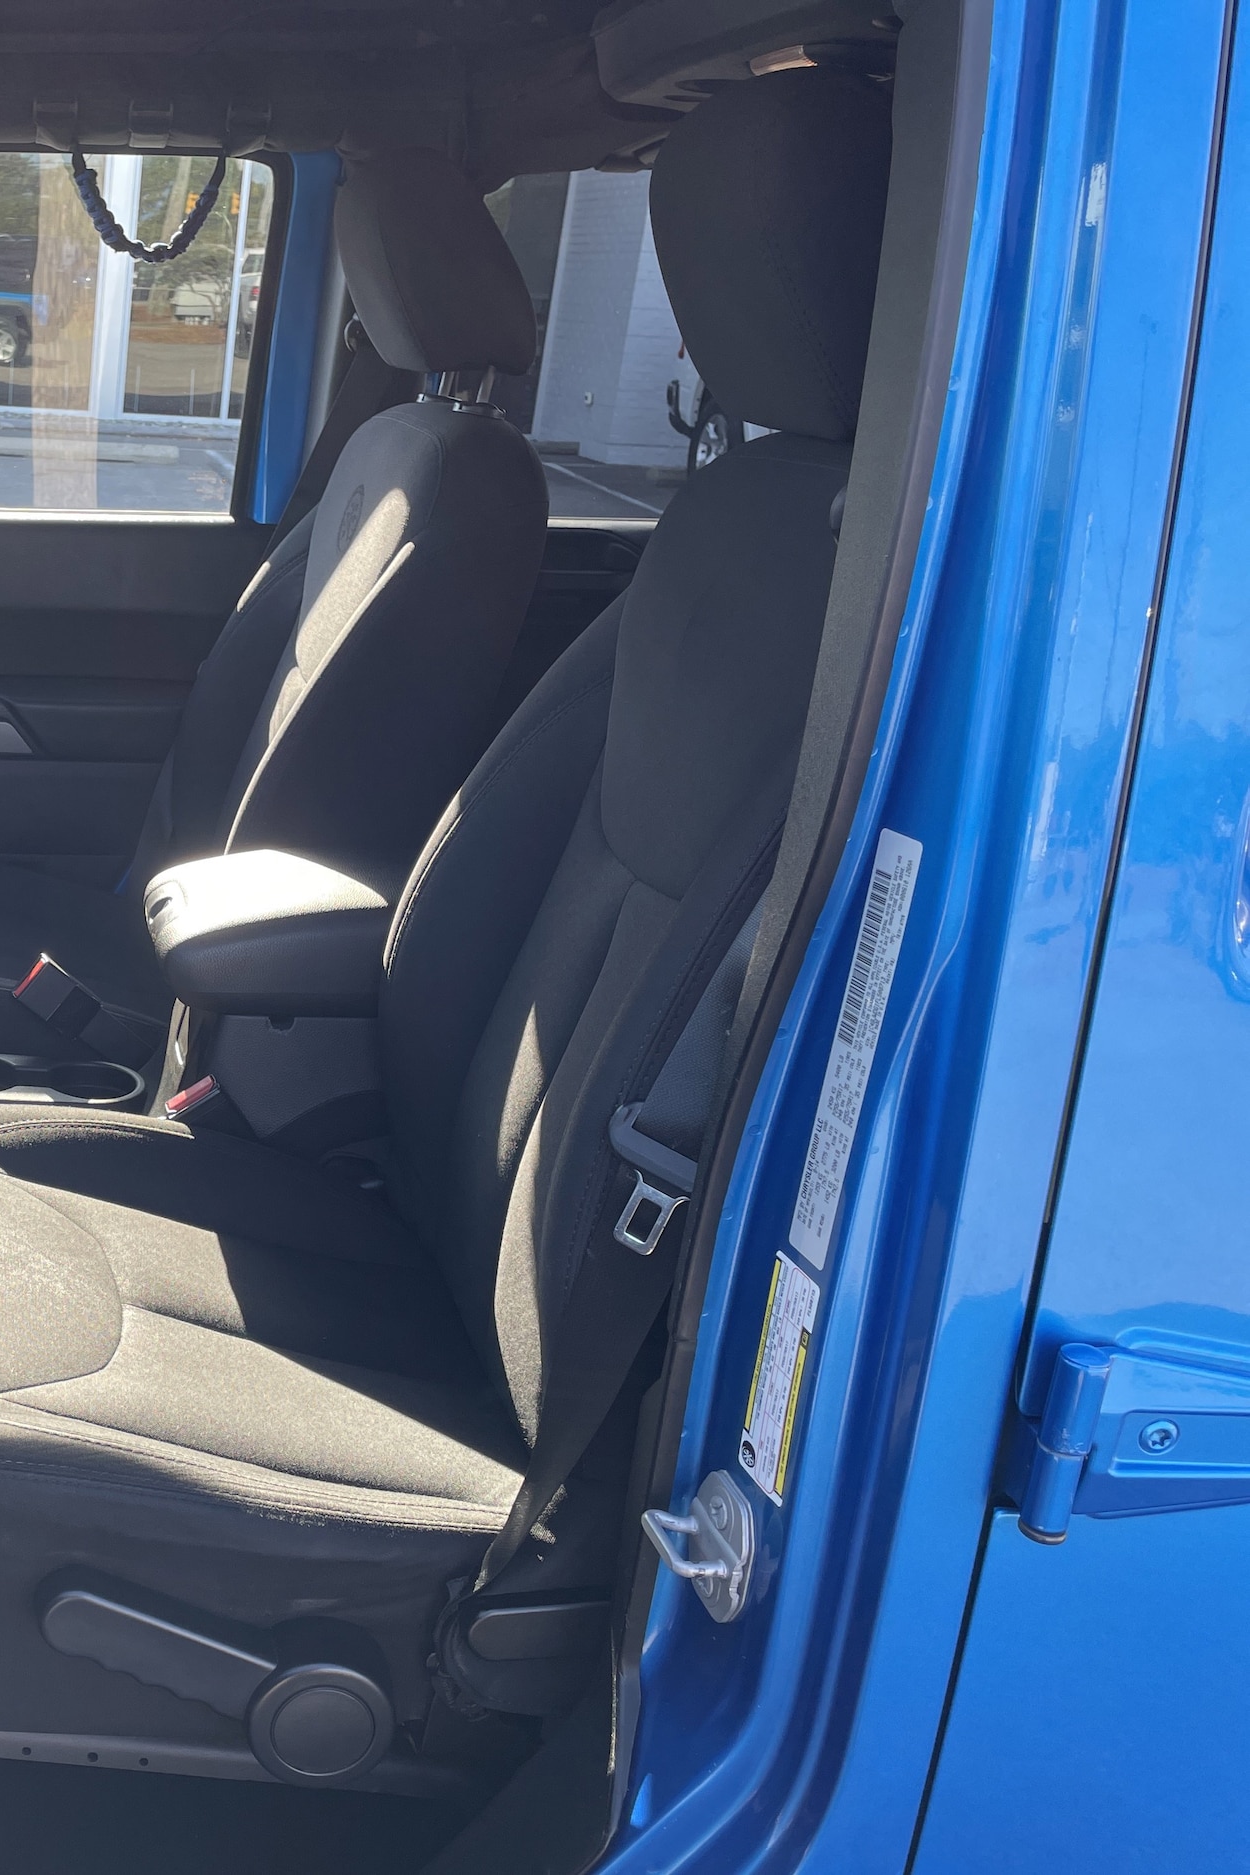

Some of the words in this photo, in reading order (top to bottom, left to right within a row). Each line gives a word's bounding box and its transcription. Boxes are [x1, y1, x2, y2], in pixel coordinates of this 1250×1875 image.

[800, 1160, 813, 1199] CHRYSLER
[809, 1133, 819, 1159] GROUP
[815, 1117, 823, 1133] LLC
